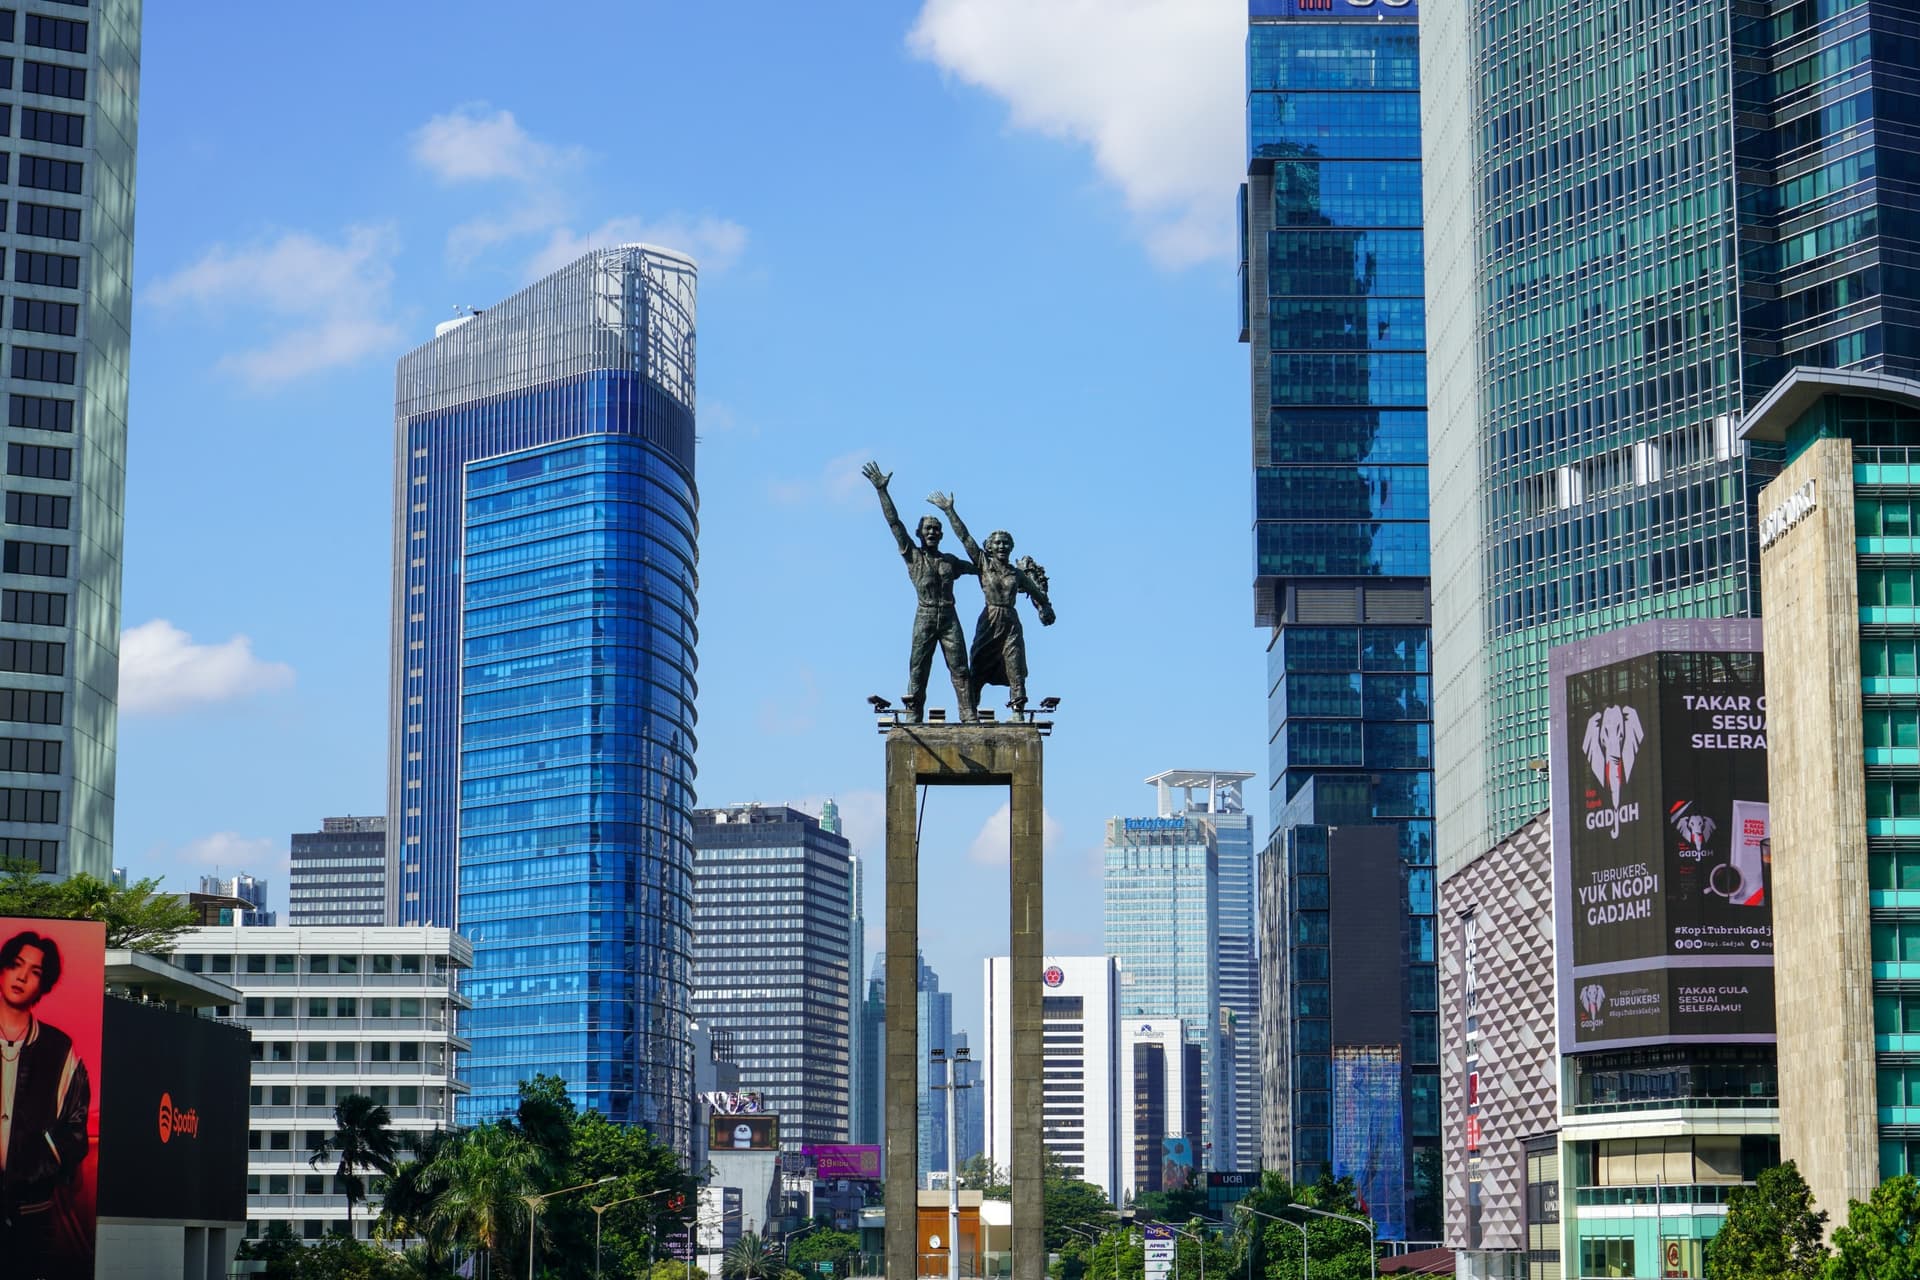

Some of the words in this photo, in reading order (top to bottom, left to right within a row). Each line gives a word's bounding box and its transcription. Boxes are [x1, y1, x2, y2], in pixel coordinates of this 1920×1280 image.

[1683, 695, 1751, 711] TAKAR
[1691, 733, 1768, 749] SELERA
[1592, 862, 1649, 884] TUBRUKERS,
[1578, 883, 1608, 905] YUK
[1611, 874, 1658, 900] NGOPI
[1587, 898, 1651, 926] GADJAH!
[1678, 987, 1716, 995] TAKAR
[1718, 986, 1749, 994] GULA
[1678, 995, 1718, 1004] SESUAI
[1678, 1003, 1742, 1013] SELERAMU!
[173, 1107, 199, 1139] Spotify
[1222, 1175, 1243, 1184] UOB
